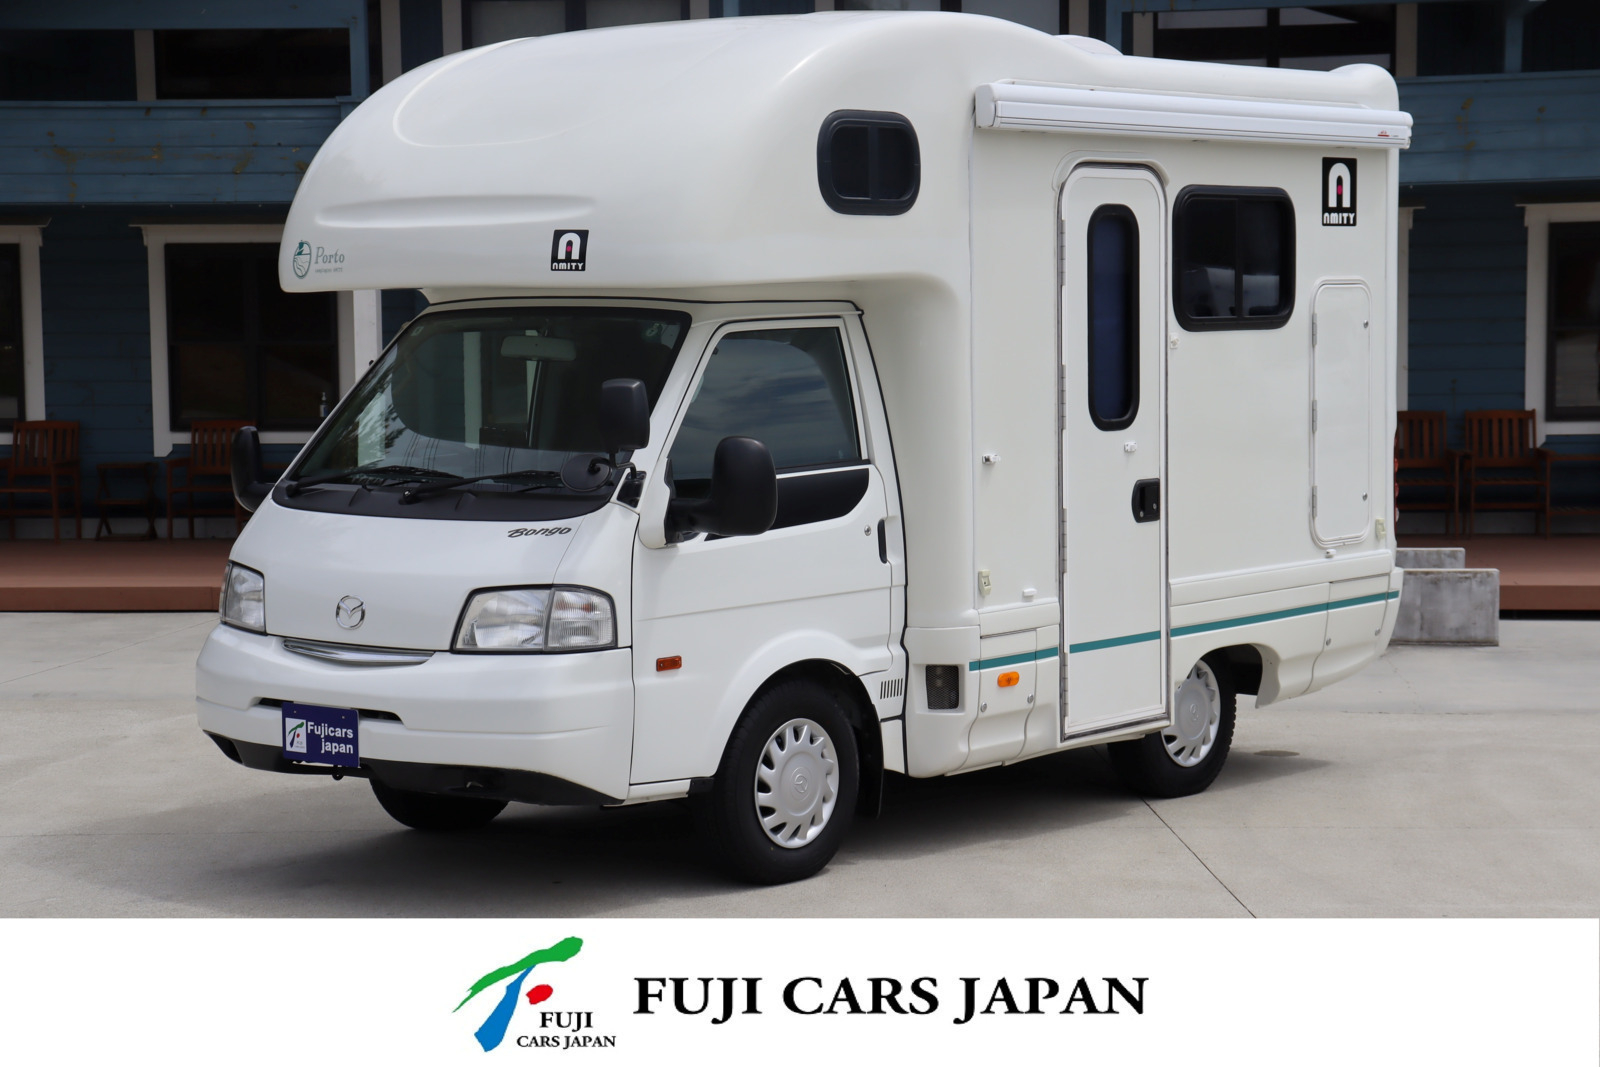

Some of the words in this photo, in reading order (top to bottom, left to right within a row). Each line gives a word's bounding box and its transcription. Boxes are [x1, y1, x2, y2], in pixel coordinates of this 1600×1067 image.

[314, 246, 345, 265] Porto
[507, 526, 572, 538] Bongo
[307, 721, 354, 739] Fujicars
[320, 738, 354, 755] japan
